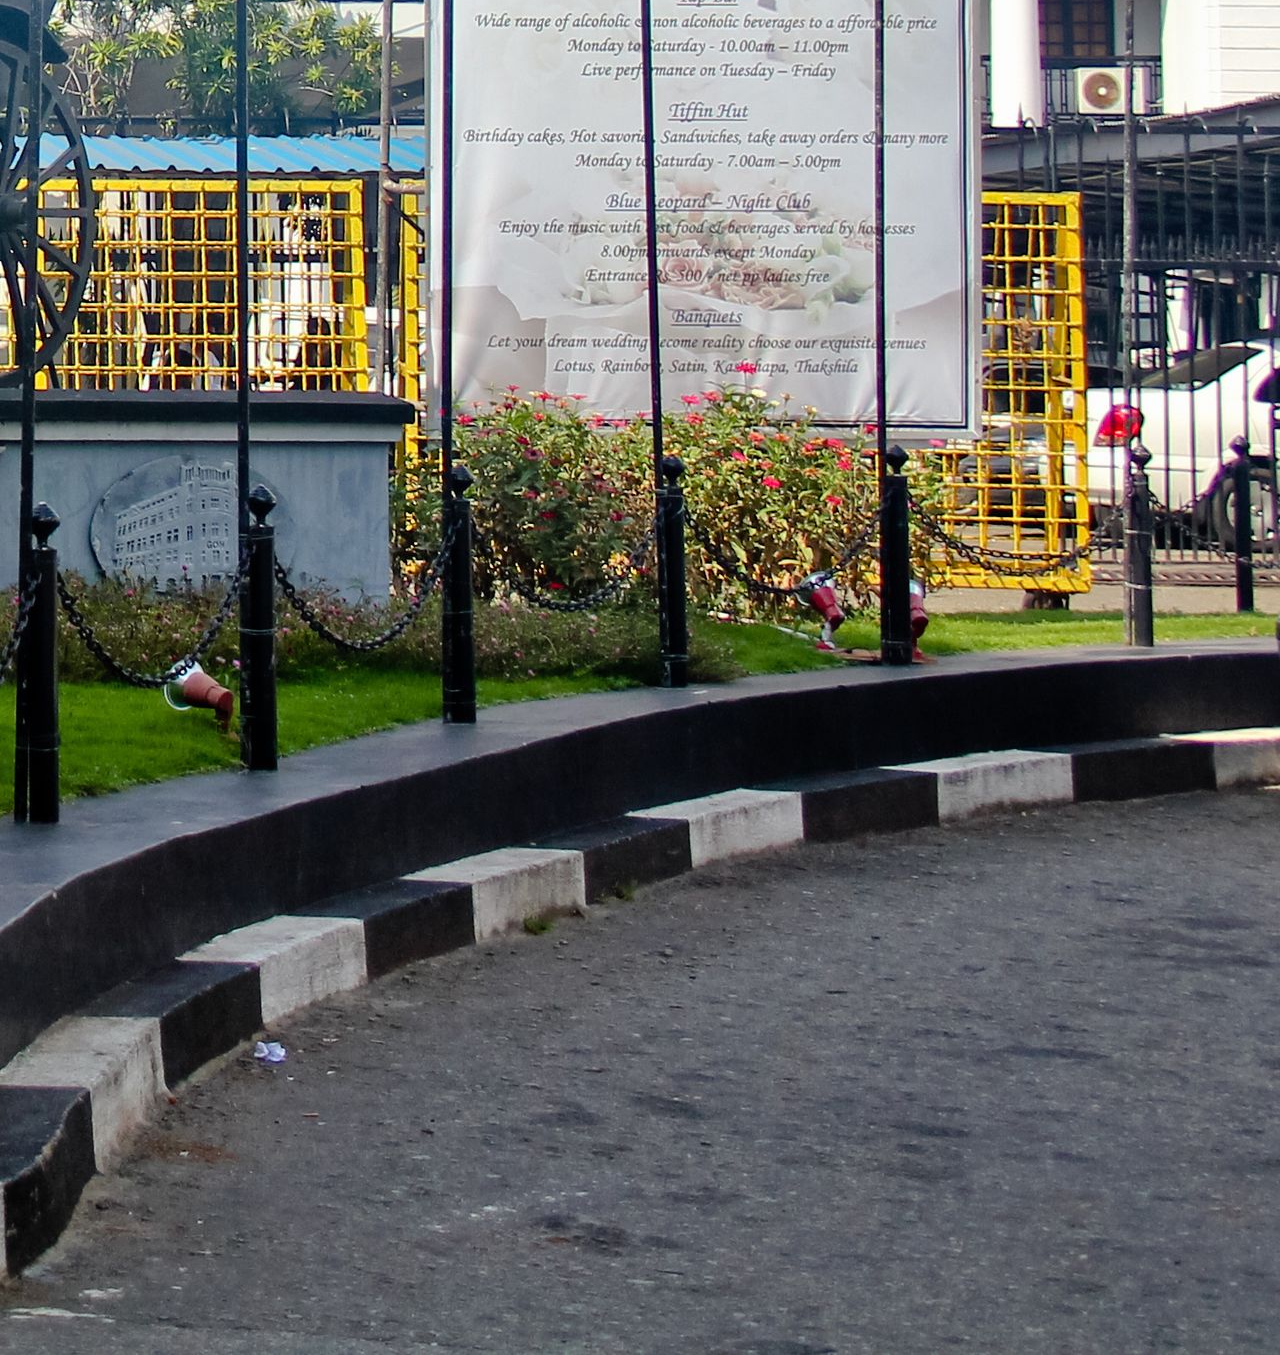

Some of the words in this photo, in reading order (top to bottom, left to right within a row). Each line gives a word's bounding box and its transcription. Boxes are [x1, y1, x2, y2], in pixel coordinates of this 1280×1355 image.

[475, 12, 511, 28] Wide
[515, 16, 551, 32] range
[555, 13, 572, 32] of
[572, 12, 631, 28] alcoholic
[652, 17, 678, 28] non
[681, 13, 739, 29] alcoholic
[743, 14, 805, 33] beverages
[809, 16, 822, 29] to
[825, 20, 834, 29] a
[907, 16, 938, 33] price
[567, 38, 624, 56] Monday
[627, 40, 641, 52] to
[719, 39, 775, 53] 10.00am
[792, 40, 849, 57] 11.00pm
[581, 63, 612, 77] Live
[699, 67, 716, 77] on
[719, 63, 775, 81] Tuesday
[791, 63, 836, 81] Friday
[668, 101, 712, 122] Tiffin
[716, 103, 748, 119] Hut
[463, 127, 524, 147] Birthday
[527, 128, 566, 146] cakes,
[569, 128, 596, 144] Hot
[660, 129, 742, 146] Sandwiches,
[747, 129, 776, 145] take
[779, 132, 816, 148] away
[819, 129, 859, 145] orders
[918, 134, 949, 145] more
[575, 153, 632, 172] Monday
[653, 154, 713, 172] Saturday
[726, 155, 775, 169] 7.00am
[792, 155, 841, 172] 5.00pm
[605, 193, 642, 209] Blue
[726, 193, 772, 213] Night
[775, 194, 811, 210] Club
[499, 219, 540, 237] Enjoy
[543, 219, 564, 233] the
[567, 220, 606, 234] music
[609, 219, 641, 233] with
[674, 220, 704, 239] food
[727, 220, 790, 239] beverages
[793, 220, 835, 235] served
[838, 220, 855, 239] by
[857, 220, 916, 236] hosesses
[600, 244, 649, 261] 8.00pm
[656, 244, 711, 259] onwards
[714, 245, 756, 263] except
[759, 245, 816, 263] Monday
[585, 268, 648, 283] Entrance
[717, 271, 739, 284] net
[741, 273, 760, 287] pp
[762, 269, 806, 284] ladies
[802, 269, 830, 288] free
[674, 309, 743, 327] Banquets
[488, 334, 511, 349] Let
[513, 337, 545, 352] your
[547, 333, 588, 349] dream
[592, 333, 648, 352] wedding
[702, 334, 744, 353] reality
[748, 334, 792, 349] choose
[794, 338, 816, 350] our
[820, 335, 878, 353] exquisite
[554, 358, 596, 374] Lotus,
[668, 359, 708, 374] Satin,
[794, 358, 859, 374] Thakshila
